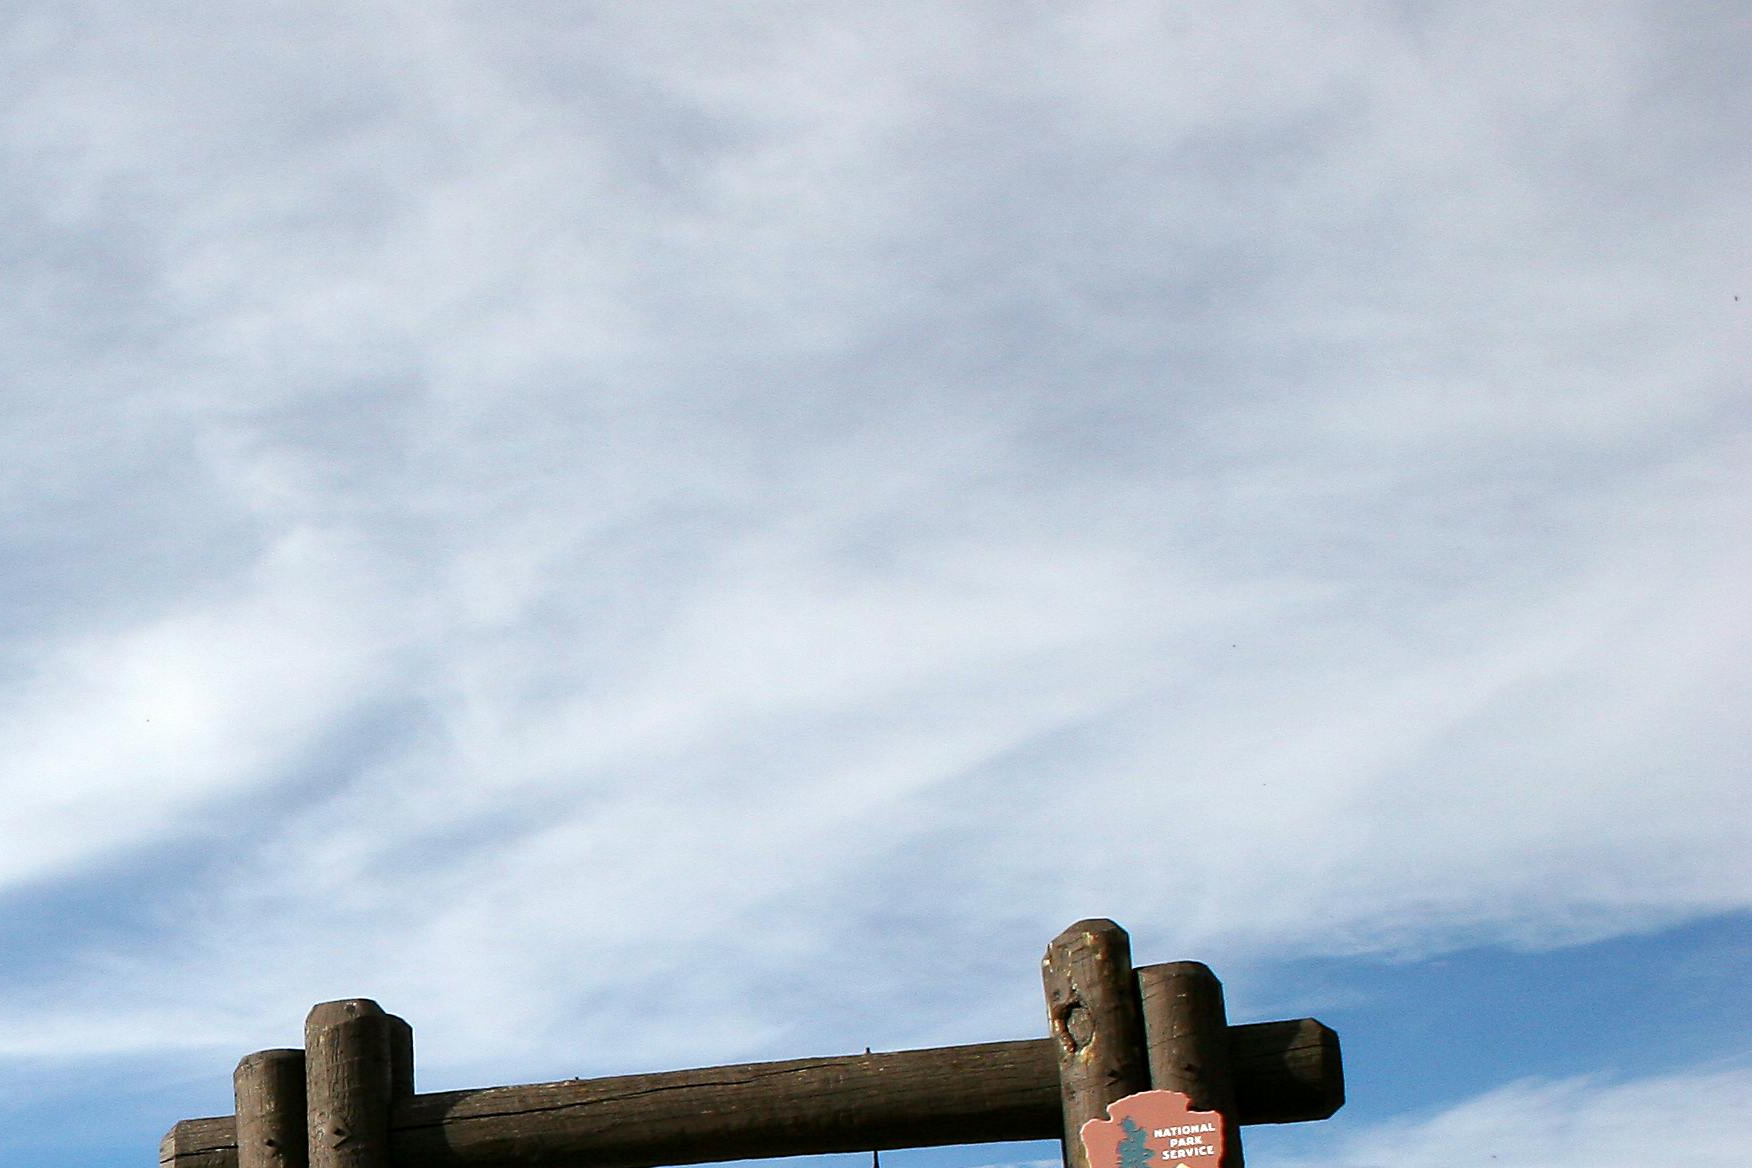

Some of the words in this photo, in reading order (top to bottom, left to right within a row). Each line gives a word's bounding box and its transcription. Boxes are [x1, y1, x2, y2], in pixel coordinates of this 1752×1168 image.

[1154, 1123, 1216, 1138] NATIONAL
[1170, 1135, 1203, 1148] PARK
[1162, 1145, 1215, 1160] SERVICE
